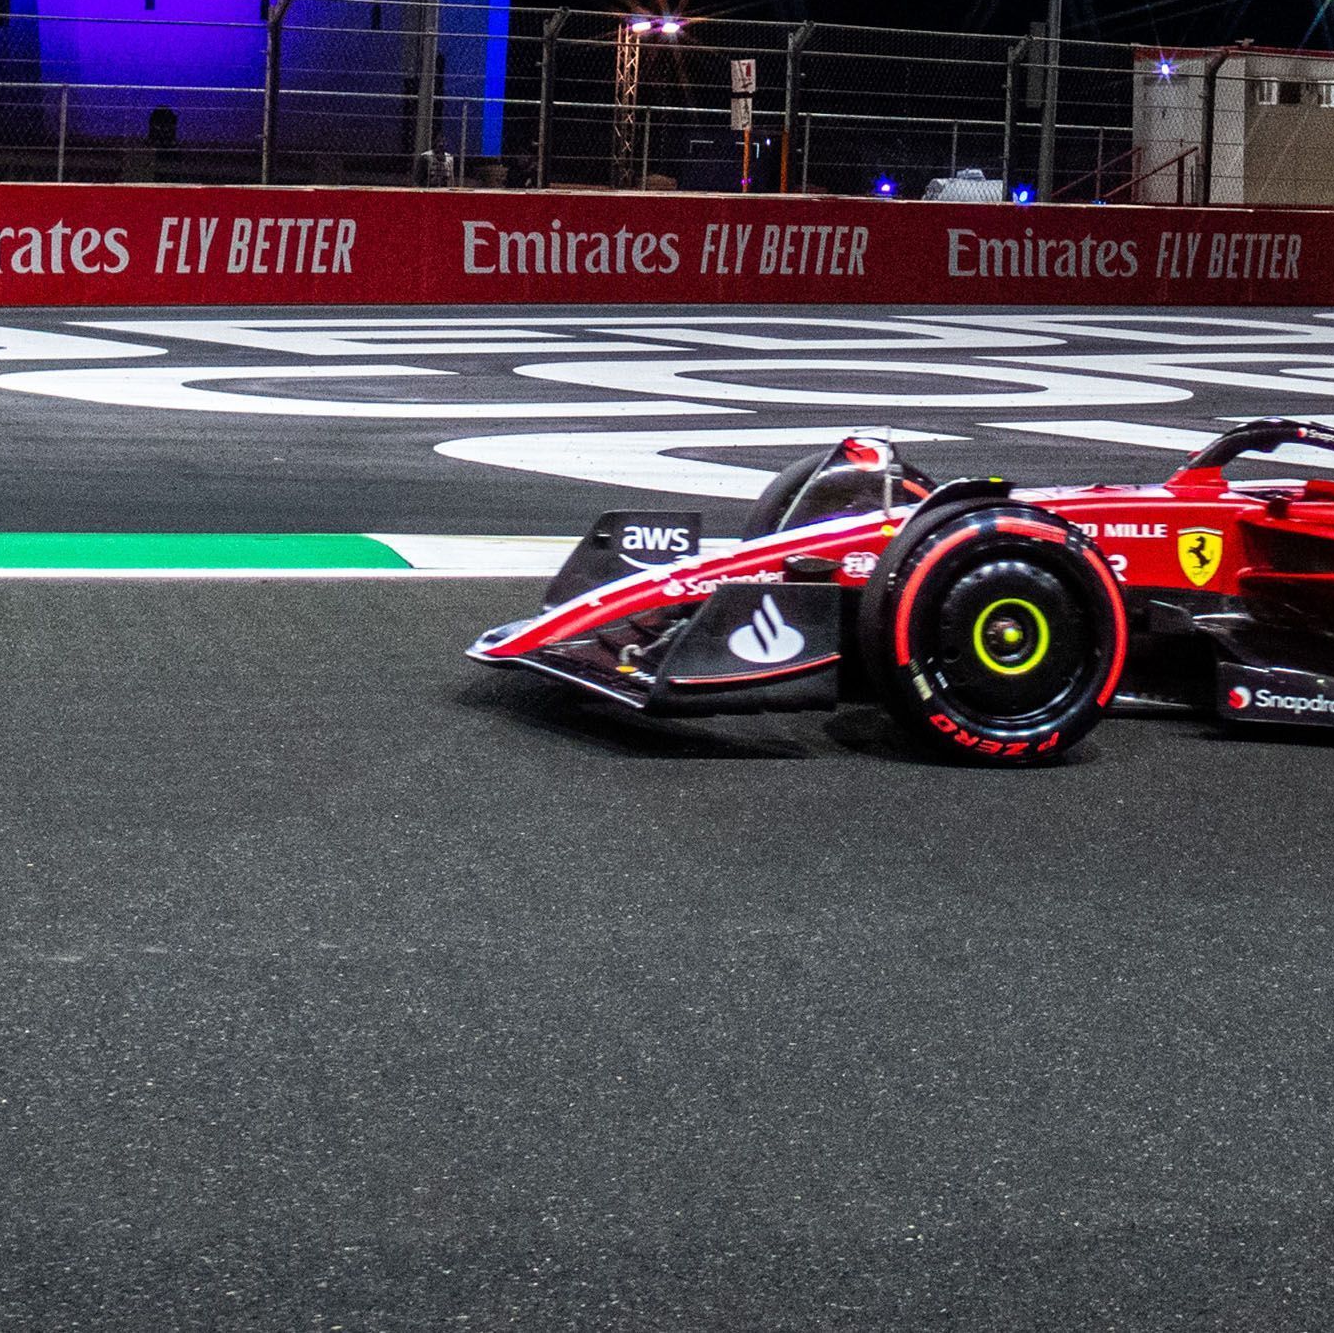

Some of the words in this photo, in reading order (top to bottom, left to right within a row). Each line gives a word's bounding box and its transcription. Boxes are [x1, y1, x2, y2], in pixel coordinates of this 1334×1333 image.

[155, 216, 218, 274] FLY
[230, 217, 357, 274] BETTER
[463, 219, 679, 274] Emirates
[699, 223, 752, 275] FLY
[758, 224, 869, 276] BETTER
[947, 228, 1138, 277] Emirates
[1155, 232, 1202, 279] FLY
[1209, 233, 1302, 280] BETTER
[621, 525, 690, 552] aws
[1103, 523, 1169, 539] MILLE
[928, 713, 1031, 757] ZERO
